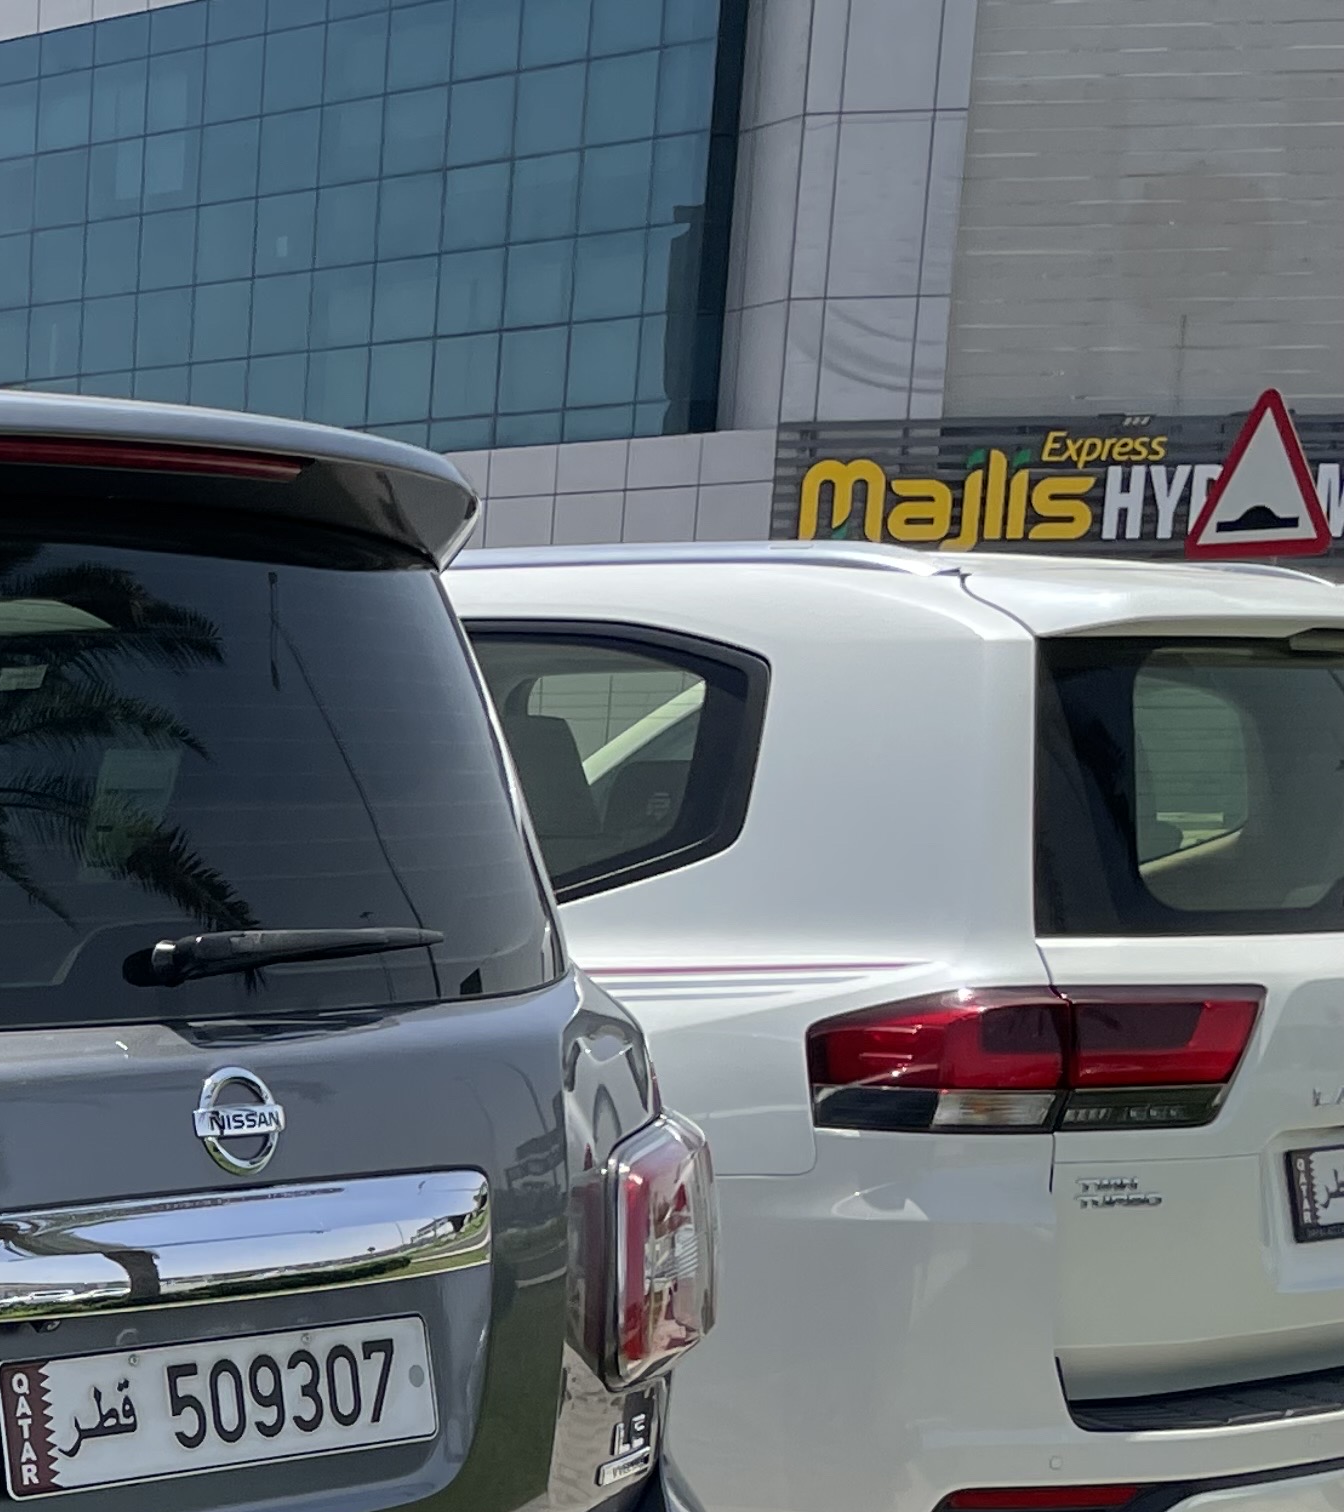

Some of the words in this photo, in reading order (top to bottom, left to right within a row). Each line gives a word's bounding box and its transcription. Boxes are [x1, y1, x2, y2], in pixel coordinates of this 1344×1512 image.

[1040, 430, 1169, 470] Express
[208, 1110, 282, 1132] NISSAN
[10, 1371, 40, 1488] QATAR
[57, 1377, 138, 1458] قطر
[166, 1337, 396, 1450] 509307
